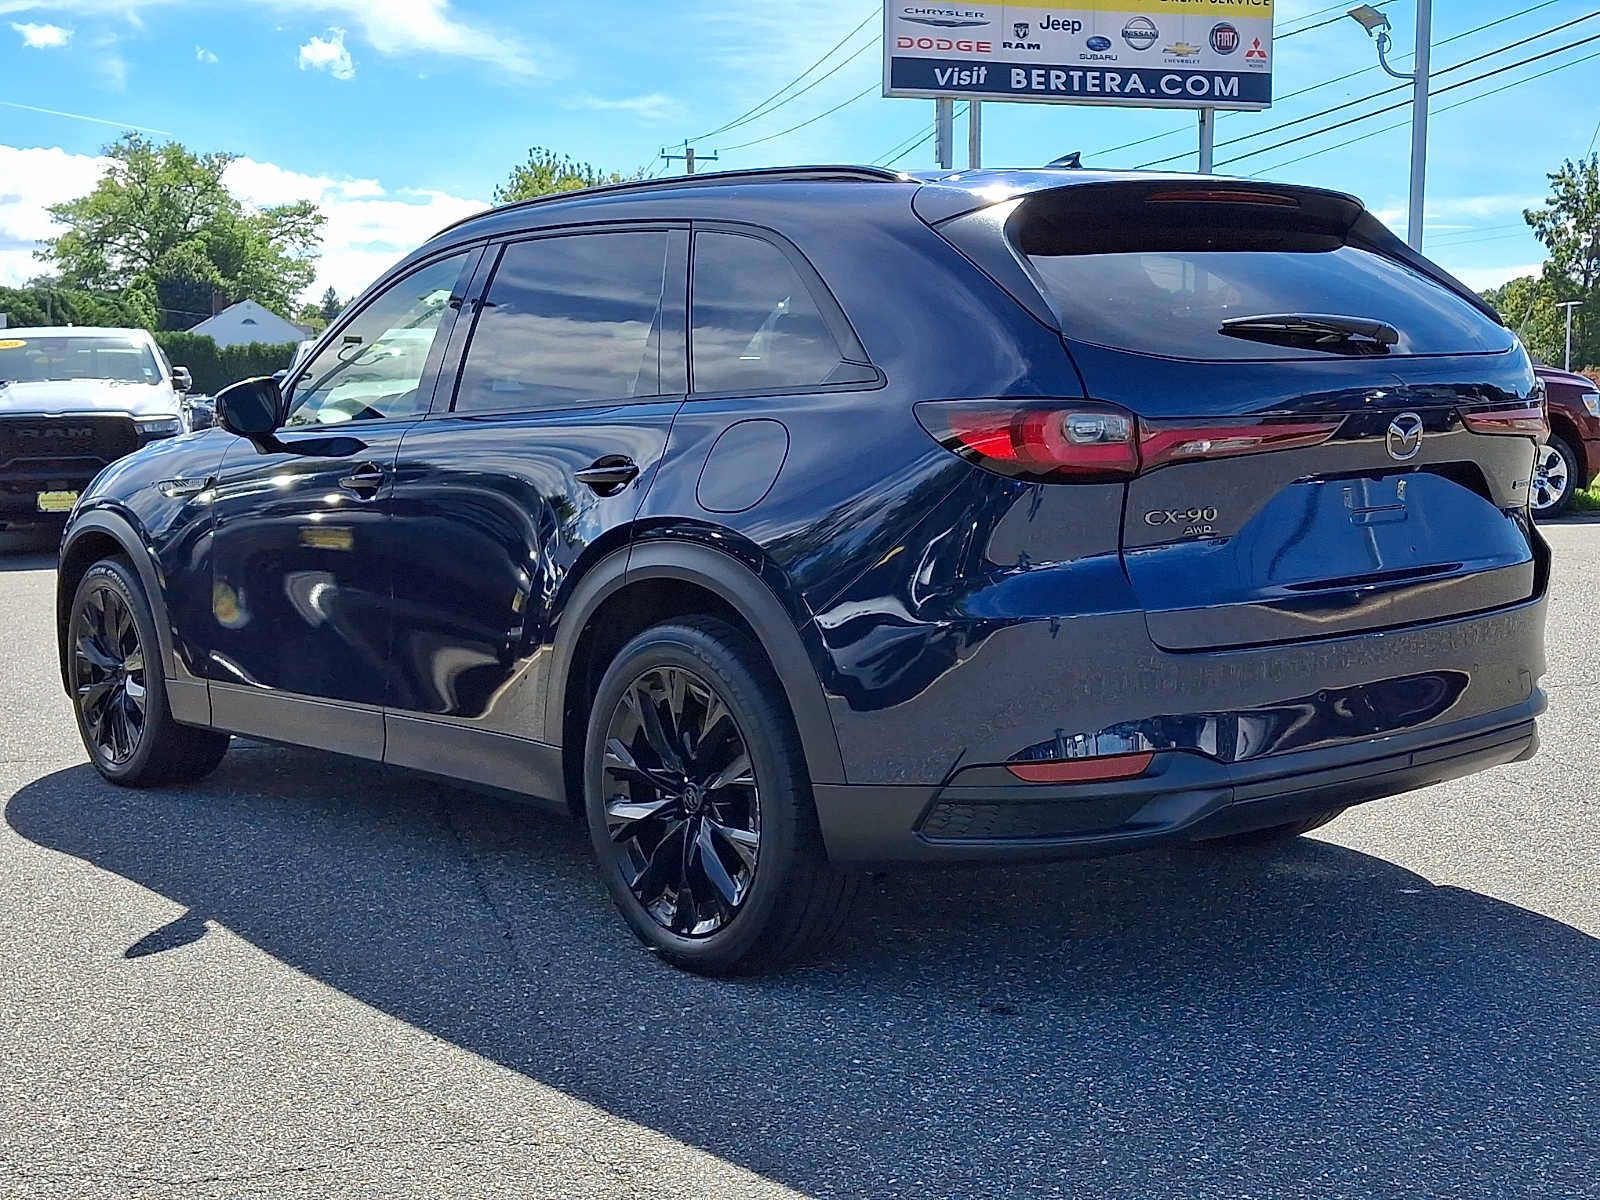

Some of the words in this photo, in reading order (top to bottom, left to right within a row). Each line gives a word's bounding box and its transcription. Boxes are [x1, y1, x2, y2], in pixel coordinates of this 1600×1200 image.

[903, 7, 985, 18] CHRYSLER
[1039, 15, 1082, 35] Jeep
[1124, 30, 1157, 39] NISSAN
[1216, 31, 1235, 47] FIAT
[897, 36, 993, 53] DODGE
[1002, 41, 1041, 50] RAM
[1079, 53, 1118, 61] SUBARU
[934, 66, 988, 87] Visit
[1010, 68, 1240, 97] BERTERA.COM
[1144, 506, 1218, 526] CX-90
[1183, 525, 1213, 536] AWD
